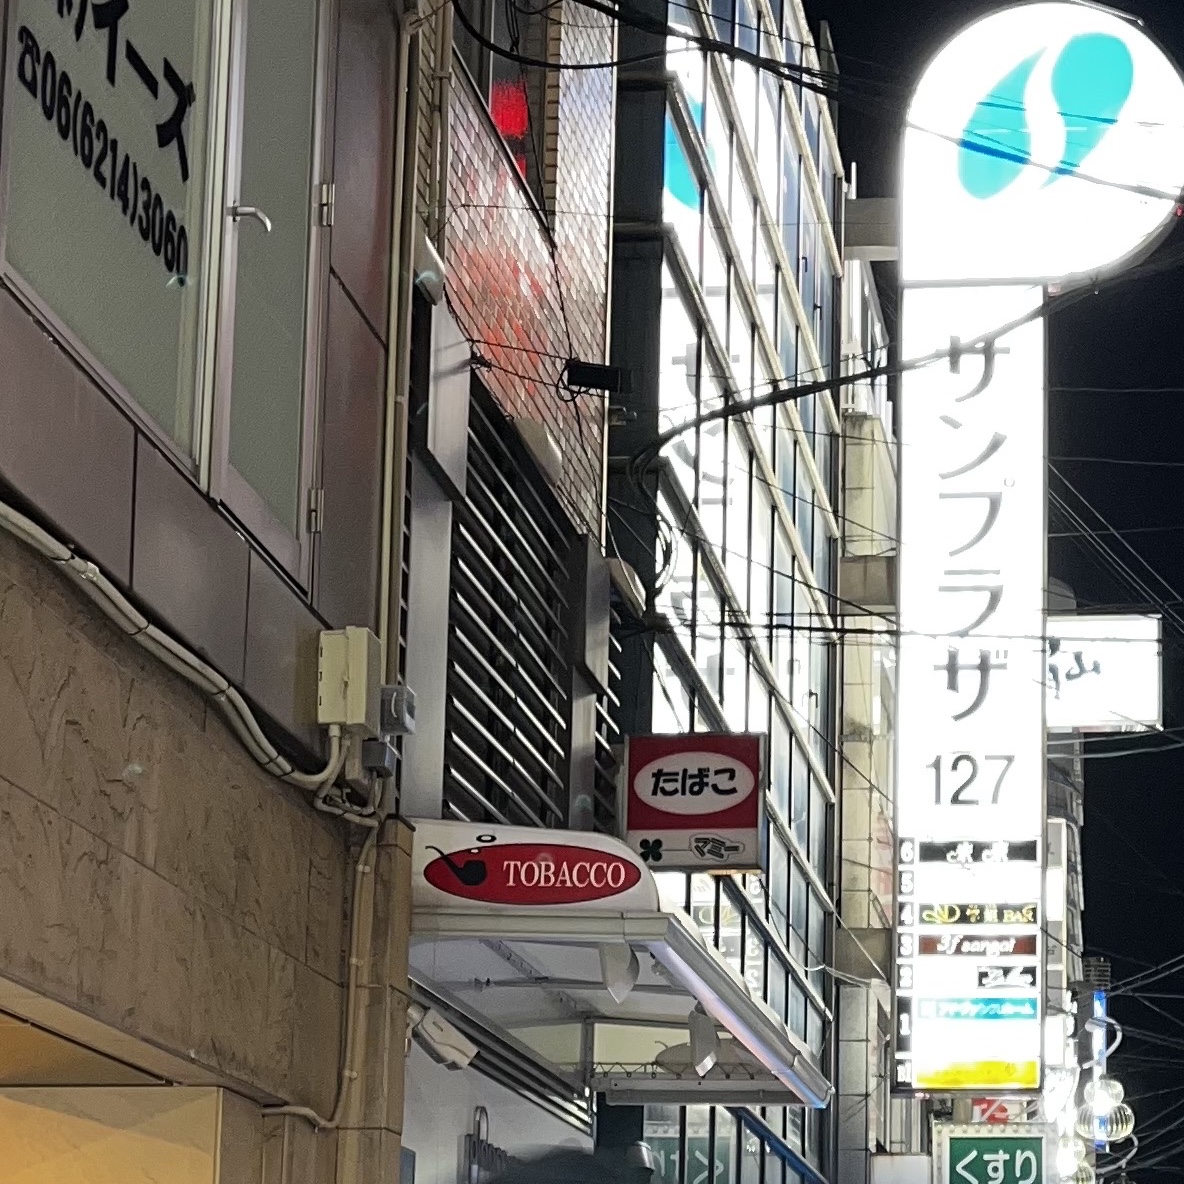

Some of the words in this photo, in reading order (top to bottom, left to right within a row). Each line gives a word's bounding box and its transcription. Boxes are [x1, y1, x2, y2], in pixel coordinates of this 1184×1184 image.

[933, 335, 1015, 721] サンプラザ
[651, 767, 739, 797] たばこ
[926, 754, 1015, 805] 127
[901, 840, 914, 863] 6
[503, 861, 626, 888] TOBACCO
[901, 903, 913, 925] 4
[900, 934, 913, 956] 3
